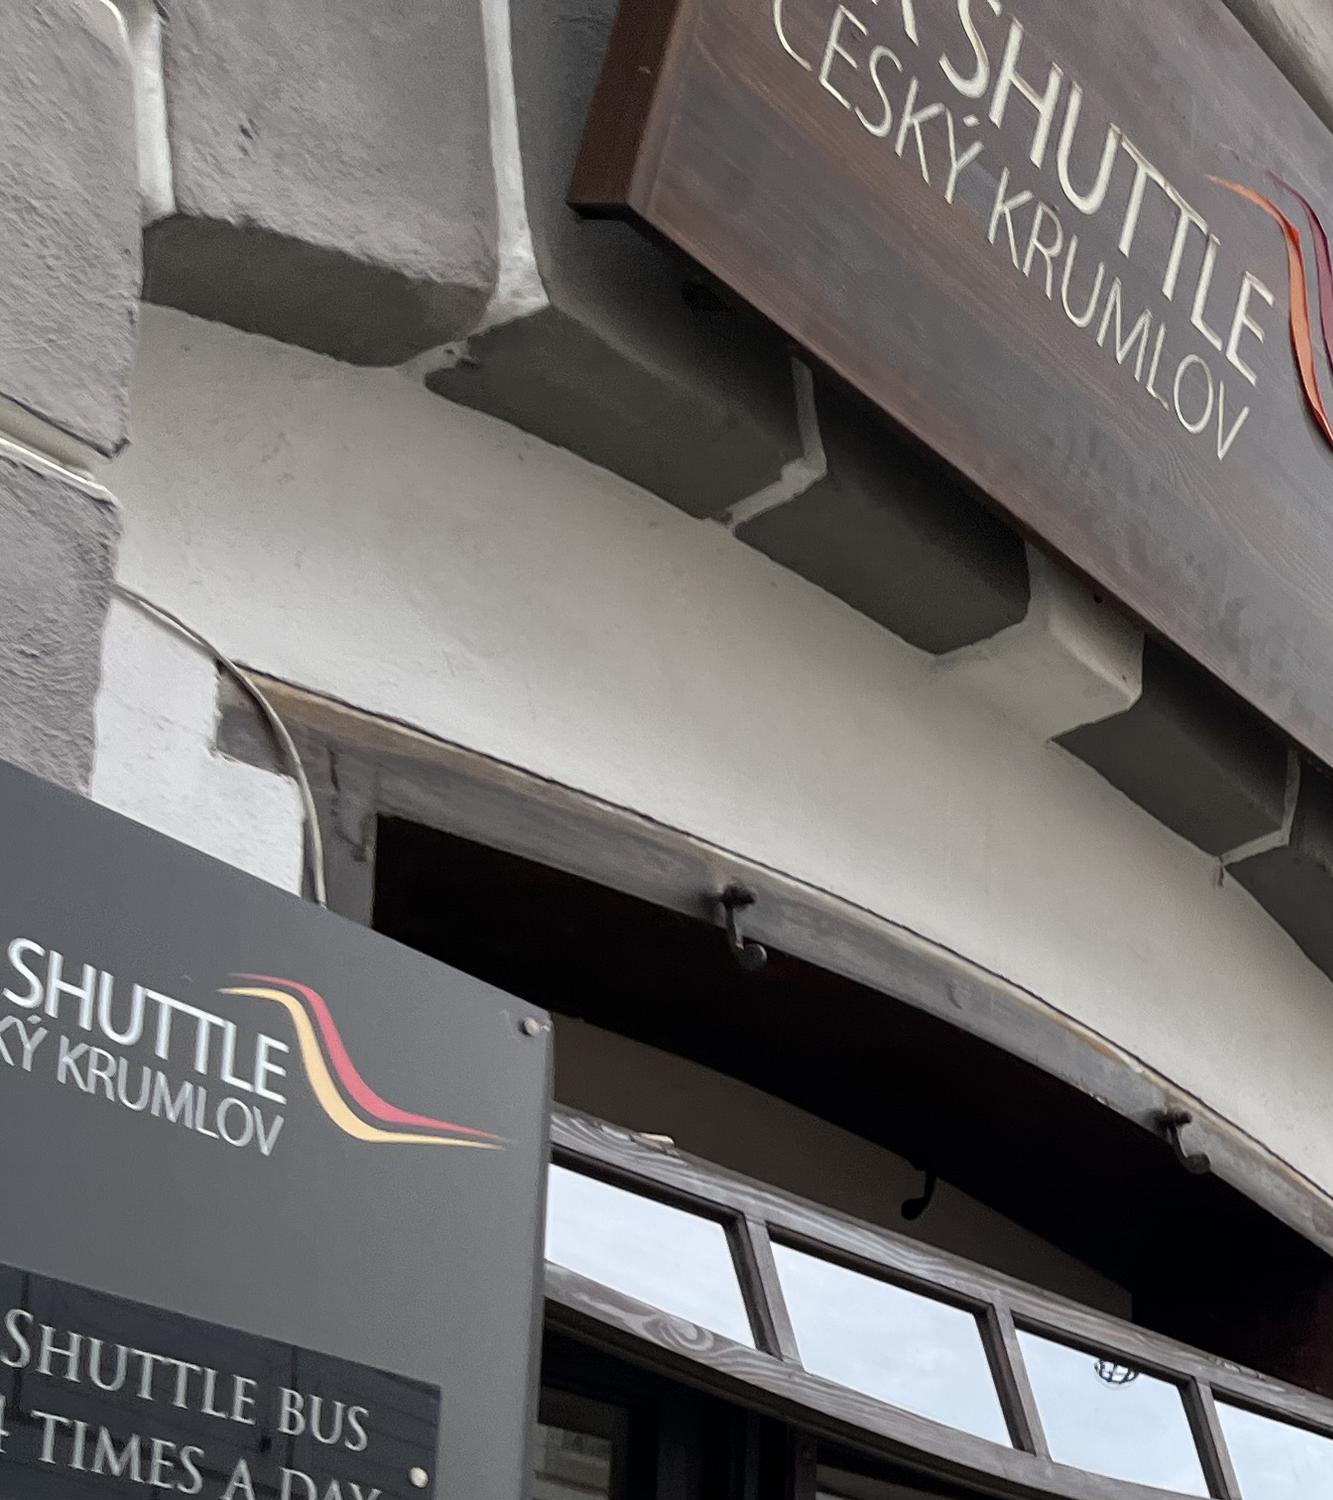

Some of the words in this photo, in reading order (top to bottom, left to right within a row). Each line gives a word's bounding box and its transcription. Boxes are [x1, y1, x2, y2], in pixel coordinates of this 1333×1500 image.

[987, 167, 1250, 460] KRUMLOV
[2, 938, 290, 1104] SHUTTLE
[57, 1034, 285, 1157] KRUMLOV
[0, 1308, 257, 1427] SHUTTLE
[276, 1387, 371, 1453] BUS
[30, 1409, 205, 1495] TIMES
